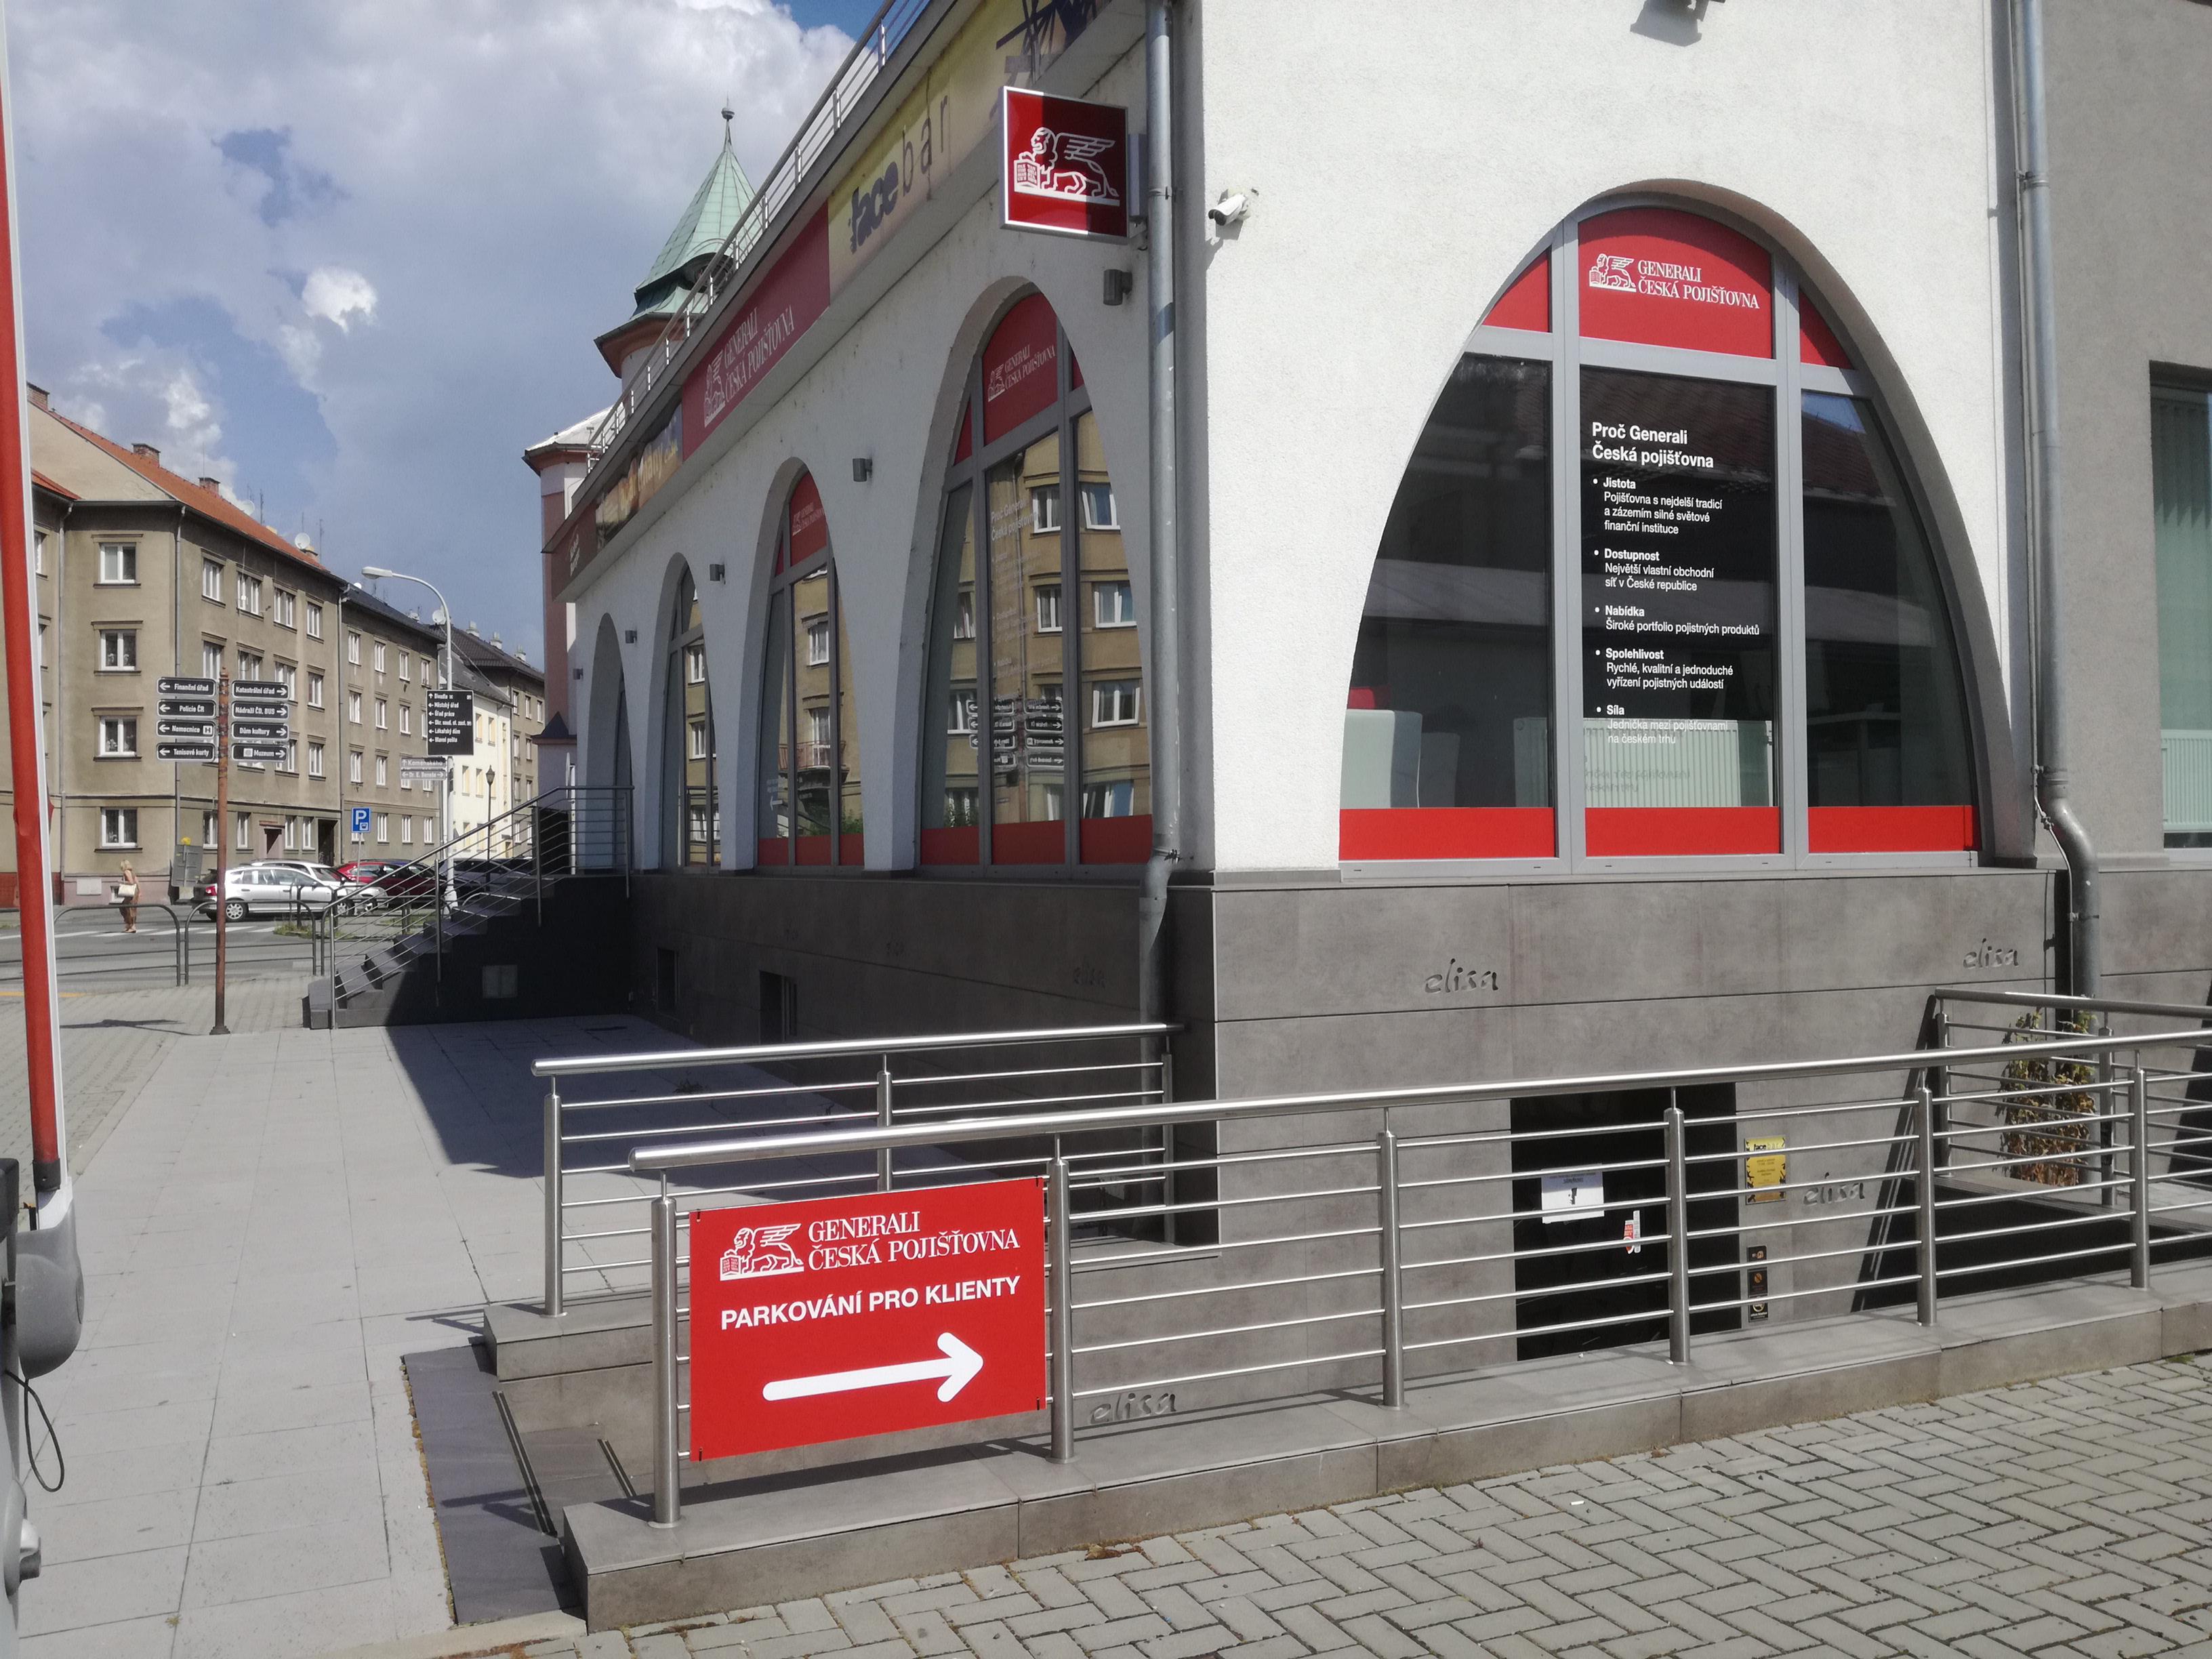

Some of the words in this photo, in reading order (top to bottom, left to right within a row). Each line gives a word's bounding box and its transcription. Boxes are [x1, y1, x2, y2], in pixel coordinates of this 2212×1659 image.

[903, 95, 947, 197] bar
[1638, 260, 1702, 283] GENERALI
[1638, 275, 1680, 299] ČESKÁ
[1683, 284, 1760, 309] POJIŠŤOVNA
[724, 307, 758, 369] GENERALI
[1004, 344, 1030, 373] GENERALI
[725, 352, 747, 403] ČESKÁ
[1593, 422, 1626, 438] Proč
[1630, 425, 1687, 445] Generali
[1593, 441, 1637, 462] Česká
[1641, 450, 1714, 468] pojišťovna
[1603, 477, 1636, 489] Jistota
[1604, 491, 1651, 504] Pojišťovna
[1660, 495, 1694, 508] nejdelší
[1696, 498, 1723, 510] tradicí
[1612, 507, 1652, 519] zázemím
[1654, 509, 1675, 520] silné
[1676, 511, 1710, 523] světové
[1604, 520, 1639, 532] finanční
[1641, 522, 1679, 534] instituce
[1604, 548, 1660, 562] Dostupnost
[1605, 562, 1641, 576] Největší
[1643, 565, 1671, 576] vlastní
[1673, 567, 1714, 578] obchodní
[1605, 577, 1617, 588] síť
[1626, 576, 1655, 589] České
[1657, 580, 1697, 592] republice
[1605, 605, 1645, 617] Nabídka
[1605, 617, 1635, 630] Široké
[1637, 622, 1673, 633] portfolio
[1675, 623, 1719, 636] pojistných
[1721, 624, 1759, 636] produktů
[1605, 648, 1664, 660] Spolehlivost
[1607, 662, 1640, 675] Rychlé,
[1642, 663, 1673, 674] kvalitní
[1683, 665, 1734, 676] jednoduché
[1607, 677, 1641, 689] vyřízení
[1643, 678, 1687, 690] pojistných
[1689, 678, 1724, 689] událostí
[1607, 705, 1624, 715] Síla
[171, 724, 201, 733] Nemocnice
[1607, 720, 1648, 730] Jednička
[1650, 720, 1671, 731] mezi
[1673, 721, 1728, 733] pojišťovnami
[1608, 735, 1619, 743] na
[1622, 733, 1656, 743] českém
[1659, 734, 1676, 743] trhu
[253, 749, 274, 757] Muzeum
[356, 810, 367, 825] P
[1963, 938, 2019, 968] elisa
[1425, 958, 1499, 994] elisa
[808, 1211, 920, 1243] GENERALI
[808, 1239, 882, 1271] ČESKÁ
[888, 1227, 1020, 1263] POJIŠŤOVNA
[721, 1290, 862, 1330] PARKOVÁNÍ
[869, 1288, 918, 1312] PRO
[926, 1275, 1021, 1305] KLIENTY
